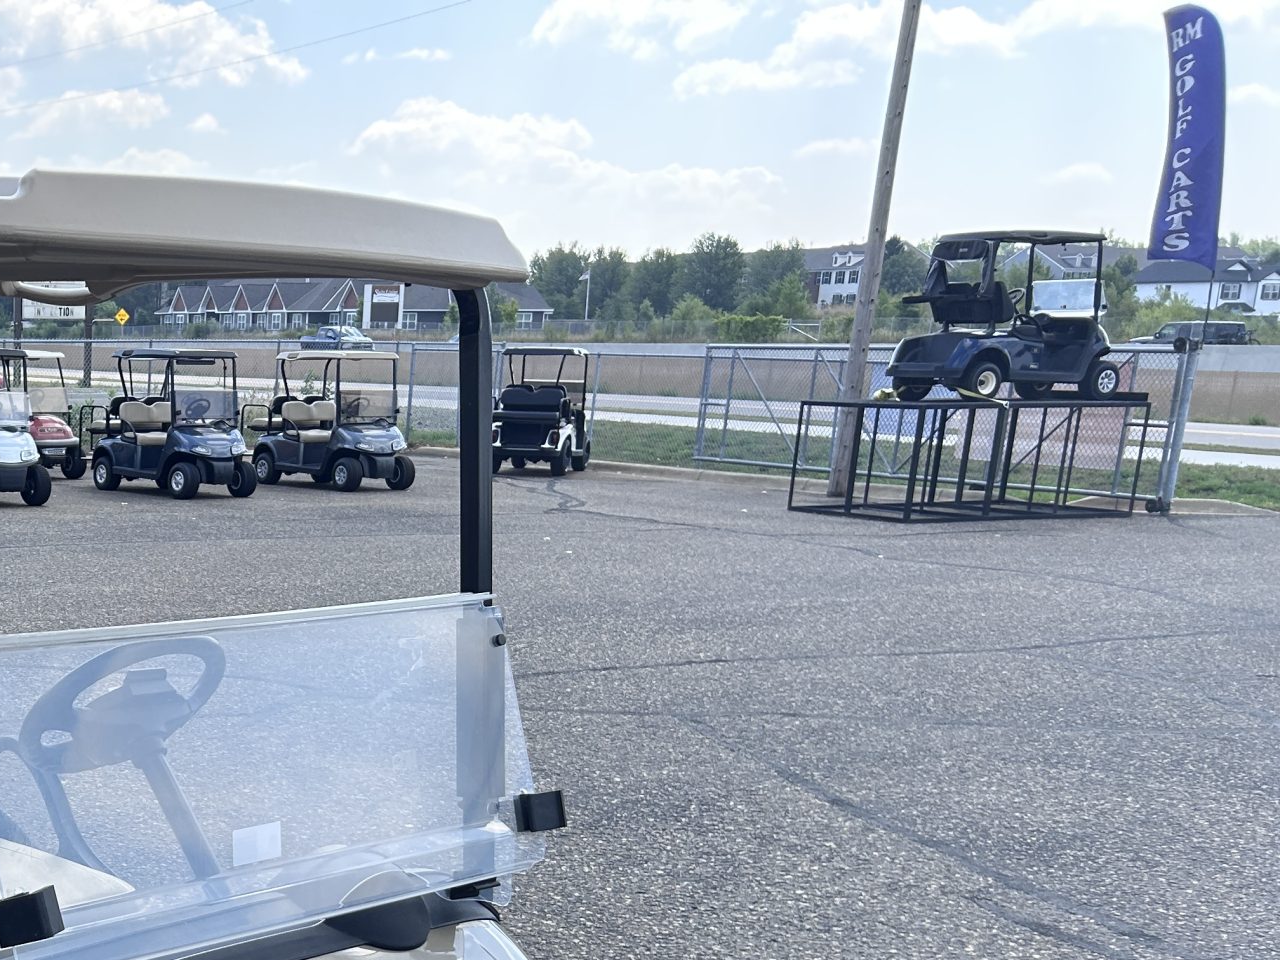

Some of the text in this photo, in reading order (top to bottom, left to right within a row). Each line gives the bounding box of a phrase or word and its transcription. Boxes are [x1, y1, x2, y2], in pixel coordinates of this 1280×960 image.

[1162, 16, 1203, 251] RM GOLF CARTS
